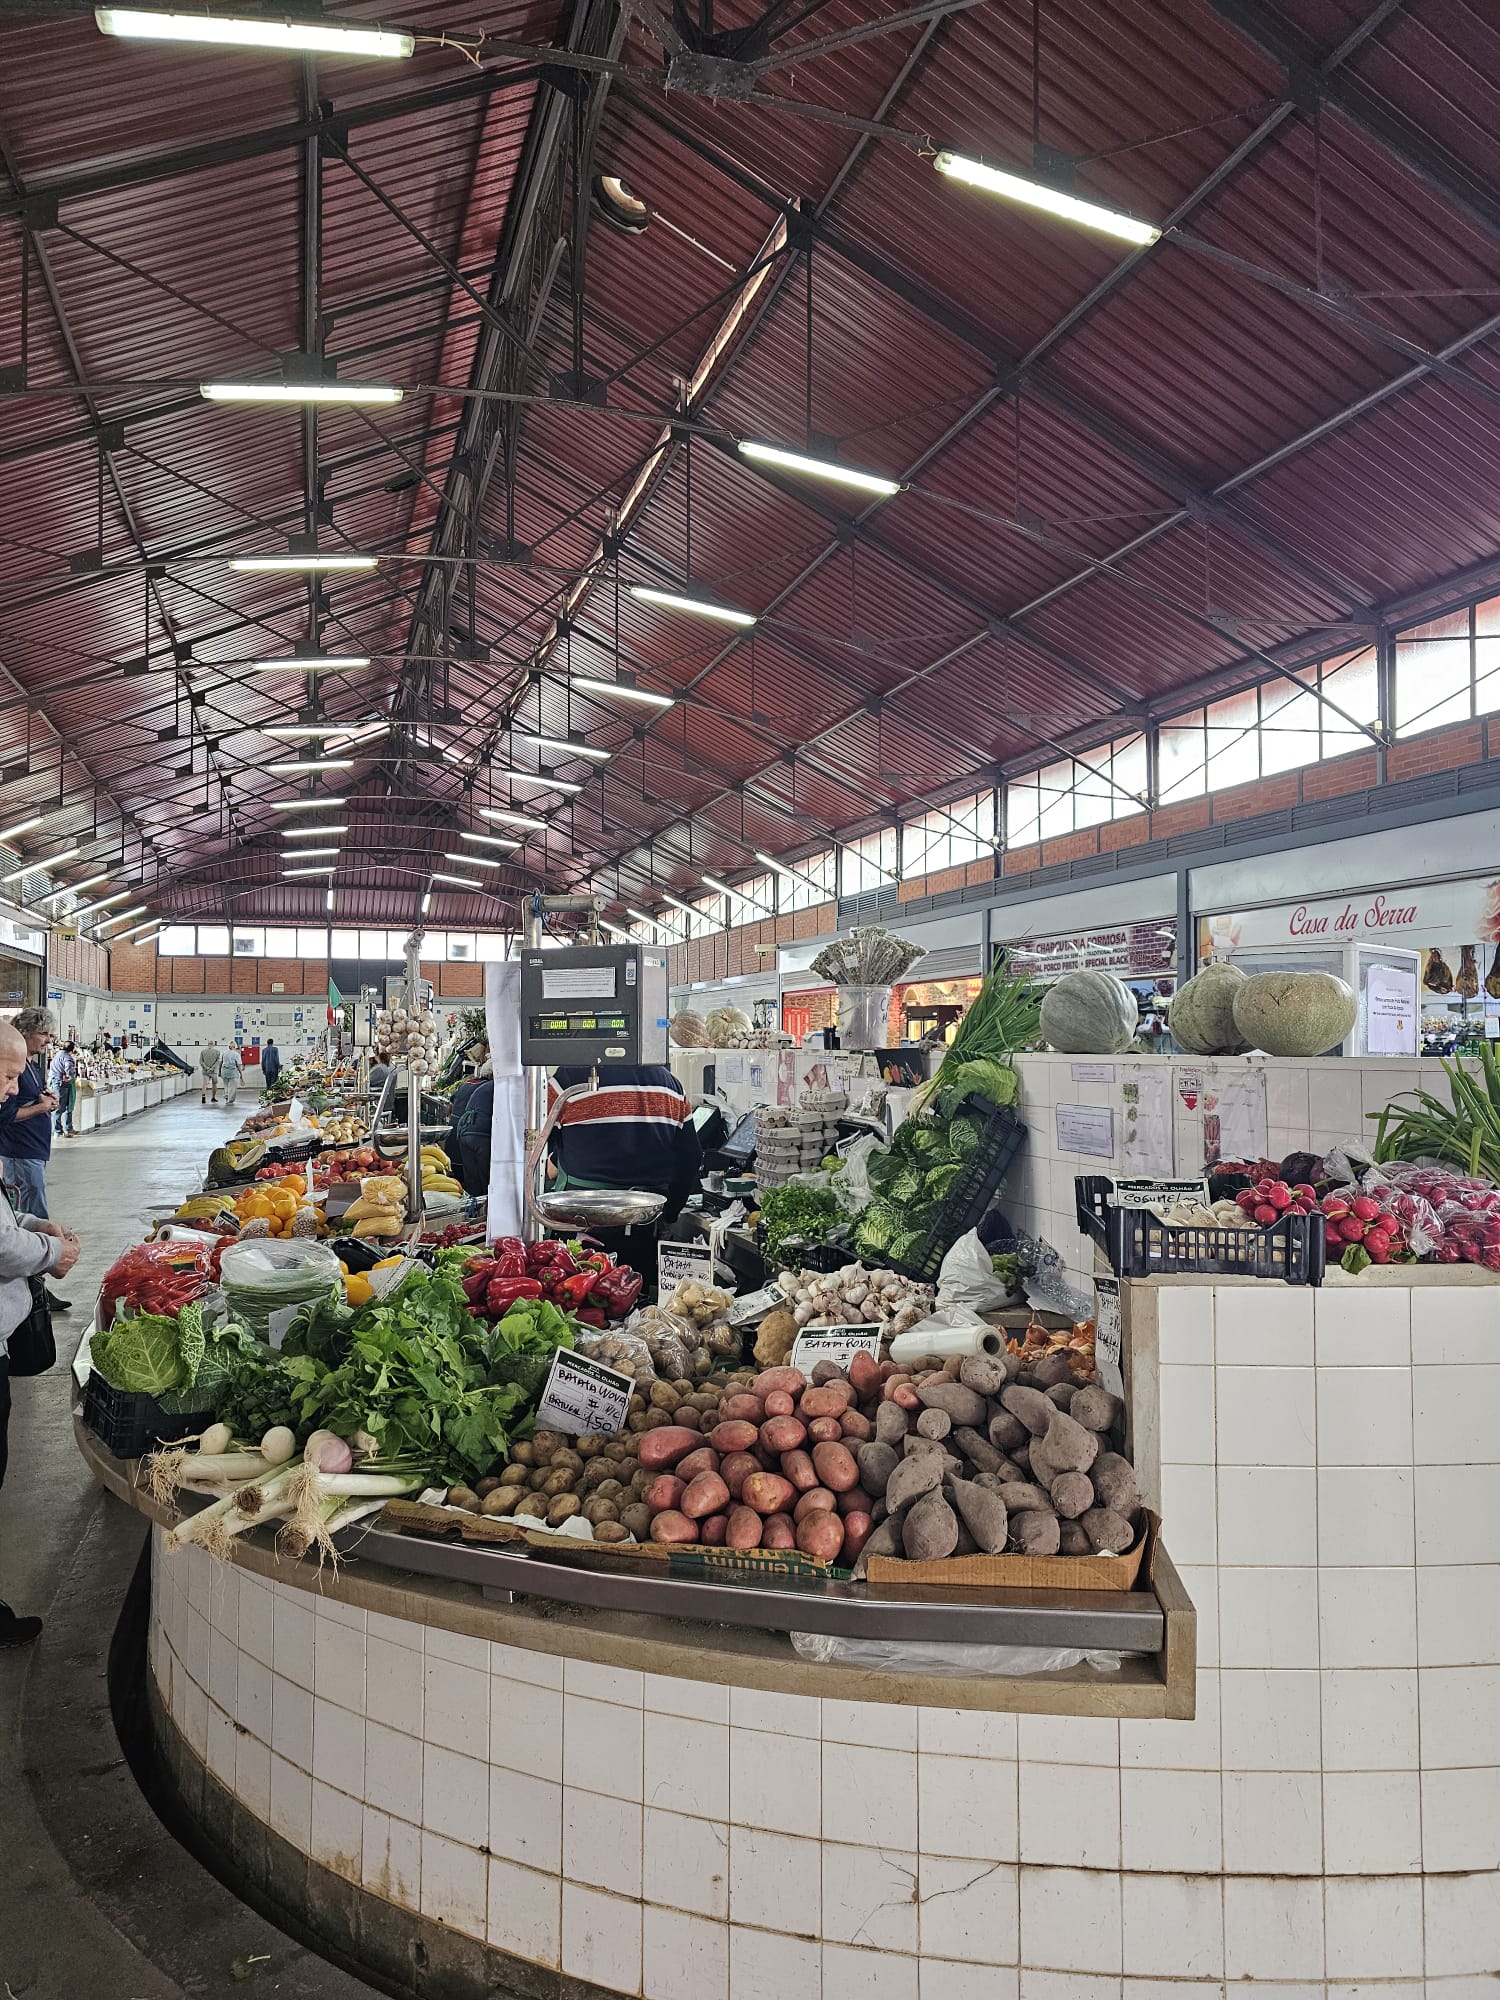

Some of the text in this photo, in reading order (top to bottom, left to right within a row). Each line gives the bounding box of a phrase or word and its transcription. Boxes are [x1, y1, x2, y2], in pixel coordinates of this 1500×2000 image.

[1289, 895, 1418, 936] Casa da Serra
[1087, 932, 1128, 950] FORMOSA
[1085, 957, 1108, 968] SPECIAL
[804, 1337, 873, 1349] BATATA ROXA
[558, 1369, 597, 1394] BATATA
[566, 1360, 595, 1378] MERCADOS
[601, 1375, 620, 1388] OLHÃO
